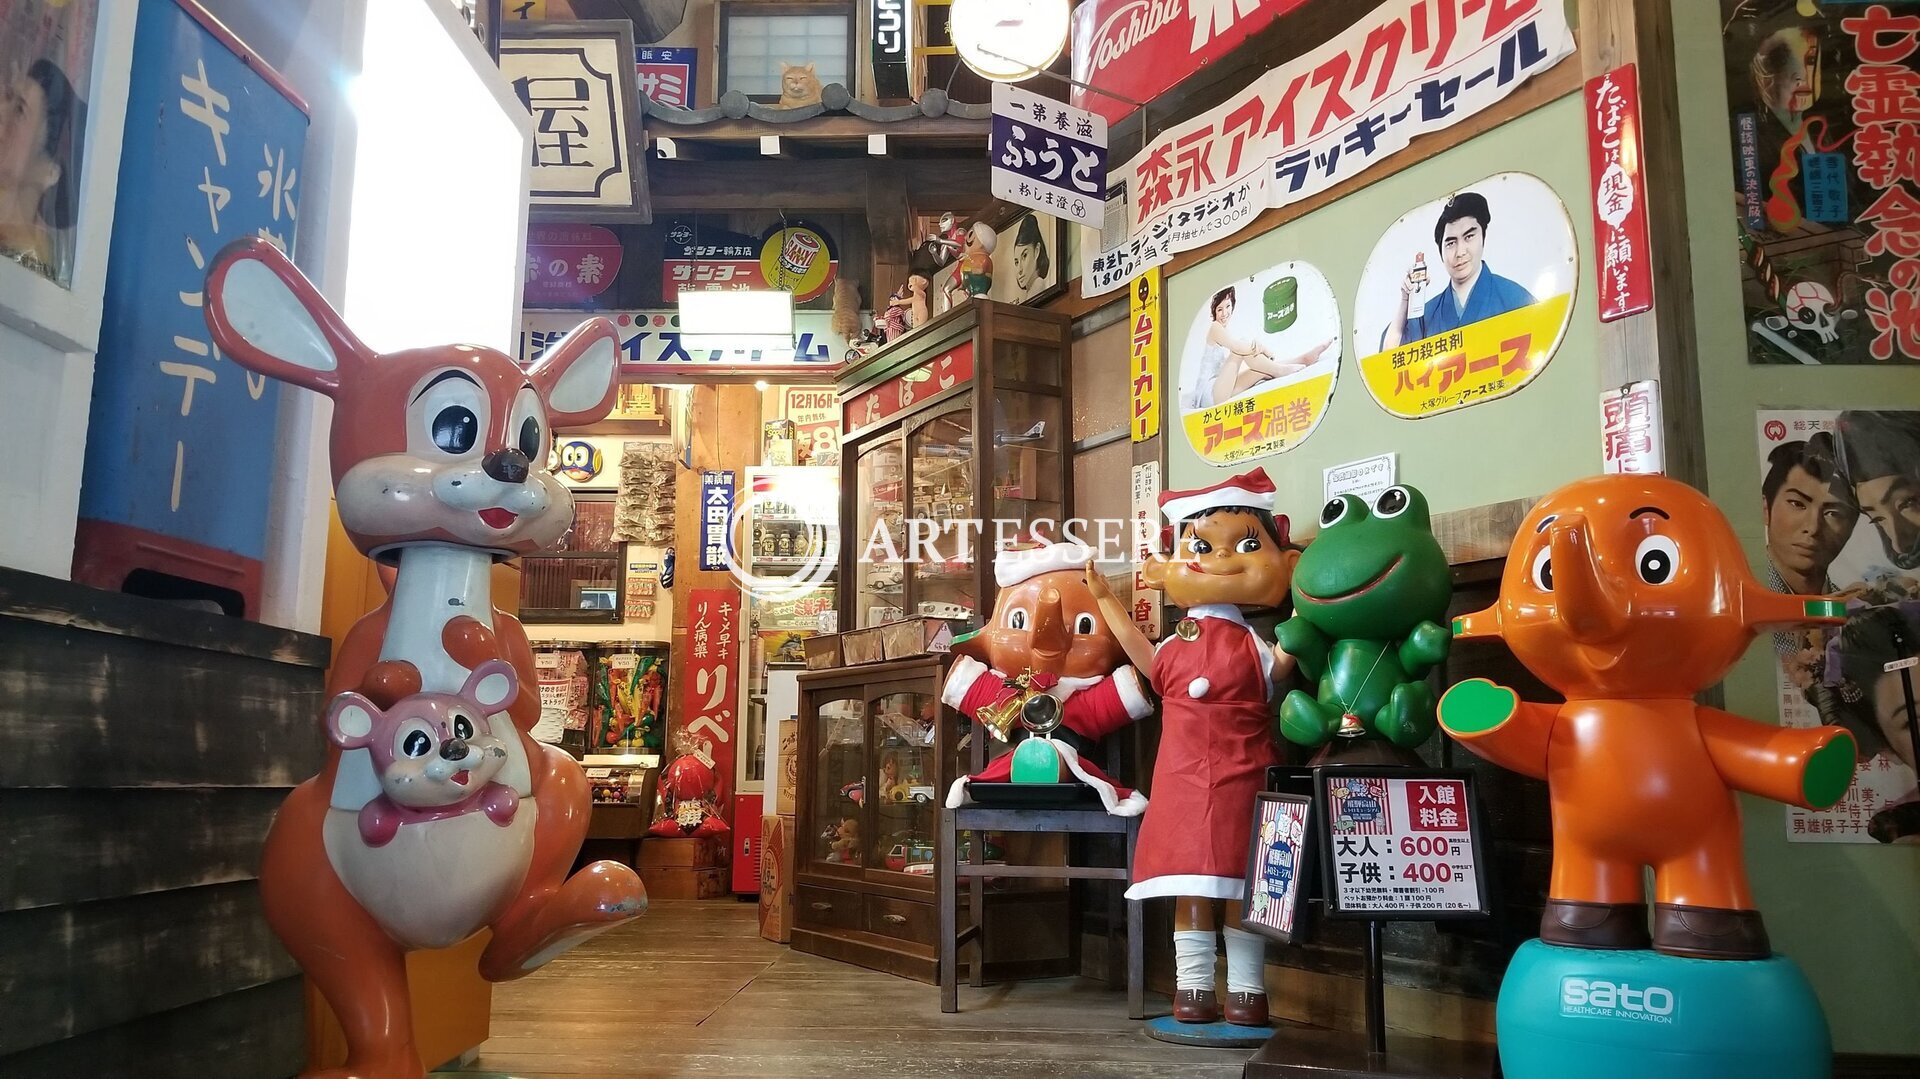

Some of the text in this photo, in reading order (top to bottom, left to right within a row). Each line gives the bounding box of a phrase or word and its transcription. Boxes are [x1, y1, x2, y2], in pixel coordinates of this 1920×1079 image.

[1077, 0, 1183, 97] Toshiba
[511, 76, 595, 168] 屋
[1275, 21, 1548, 194] ラッキーセール
[672, 265, 753, 281] サンヨー
[1391, 330, 1464, 370] 強力殺虫剤
[1394, 333, 1533, 397] ハイアース
[1202, 397, 1257, 425] かとり線香
[1203, 396, 1313, 456] アース渦巻
[706, 486, 730, 566] 太田胃散
[1418, 785, 1456, 805] 入館
[1420, 807, 1459, 828] 料金
[1563, 979, 1675, 1016] sato
[1563, 1006, 1672, 1024] HEALTHCARE INNOVATION
